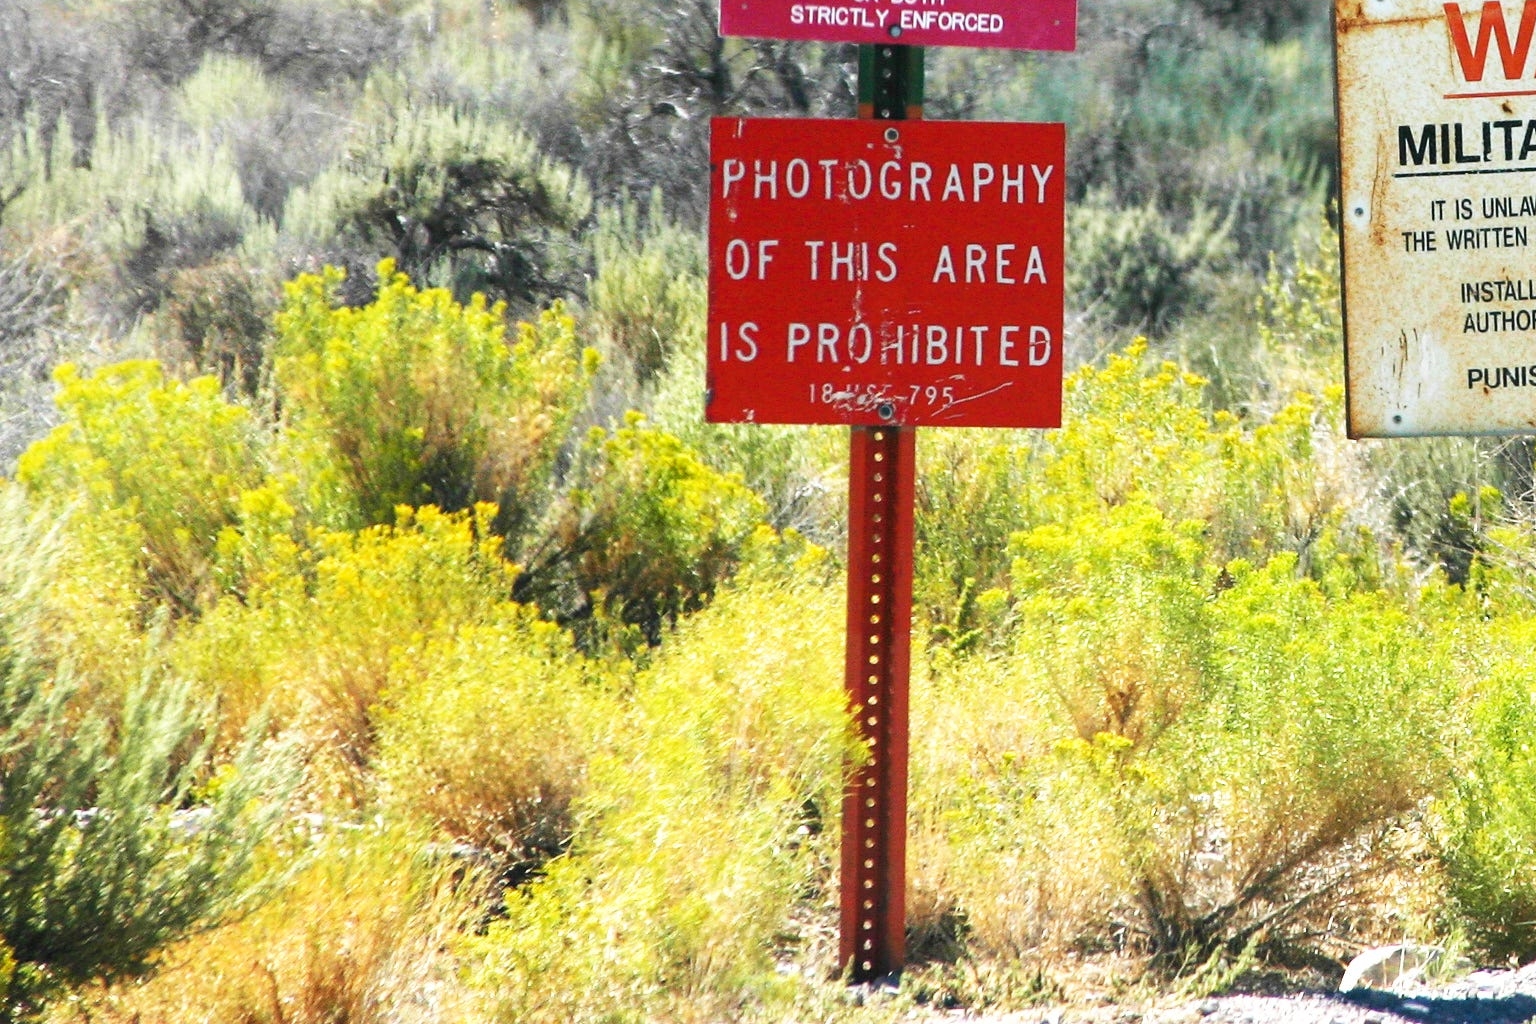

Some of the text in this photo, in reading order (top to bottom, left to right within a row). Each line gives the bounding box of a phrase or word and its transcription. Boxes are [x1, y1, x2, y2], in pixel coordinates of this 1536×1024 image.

[790, 4, 1004, 33] STRICTLY ENFORCED
[722, 158, 1054, 204] PHOTOGRAPHY
[1431, 200, 1446, 221] IT
[1456, 198, 1473, 220] IS
[1402, 231, 1436, 252] THE
[1446, 226, 1528, 250] WRITTEN
[725, 239, 1047, 285] OF THIS AREA
[720, 321, 1051, 367] IS PROHIBITED
[809, 383, 833, 404] 18
[909, 385, 954, 406] 795
